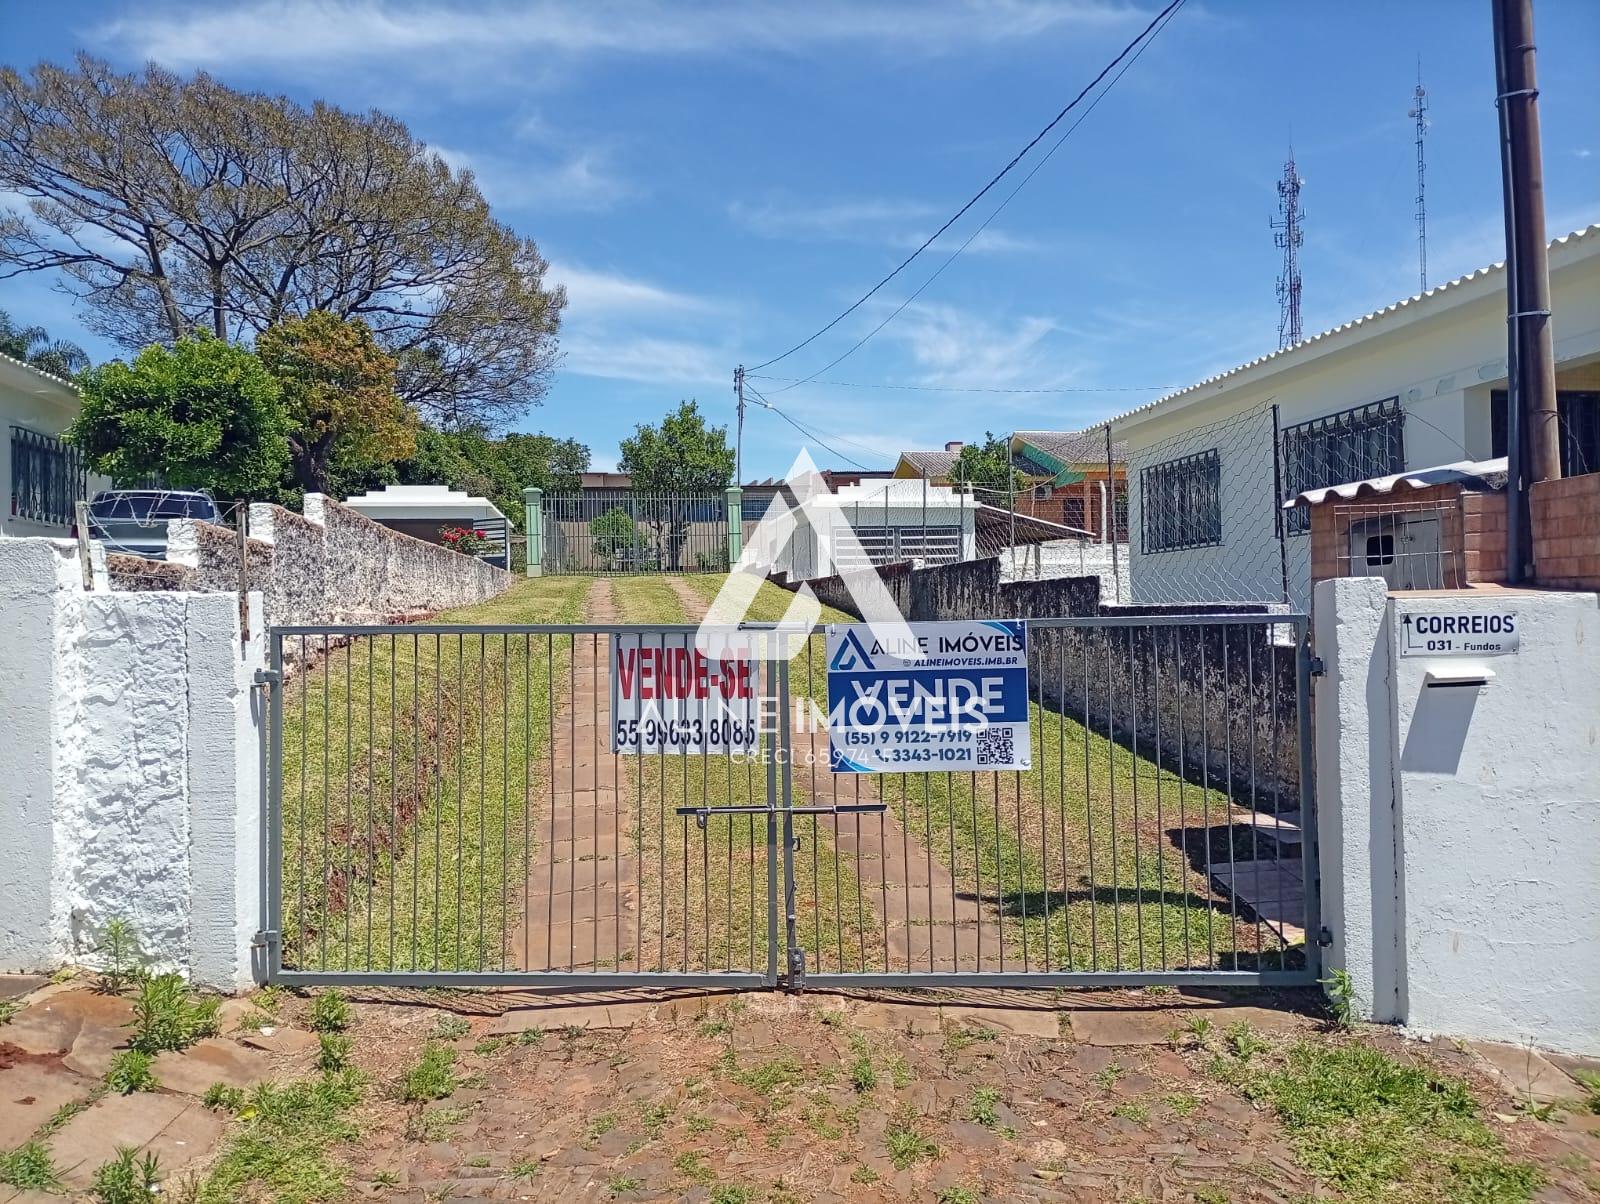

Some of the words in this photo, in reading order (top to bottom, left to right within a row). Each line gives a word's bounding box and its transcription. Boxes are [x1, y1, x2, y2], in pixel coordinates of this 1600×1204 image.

[1416, 616, 1515, 634] CORREIOS
[870, 637, 929, 655] ALINE
[939, 632, 1024, 653] IMÓVEIS
[1427, 640, 1452, 651] 031
[1464, 642, 1502, 651] Fundos
[913, 657, 1018, 667] ALINEIMOVEIS.IMB.BR
[618, 648, 754, 700] VENDE-SE
[851, 677, 1004, 717] VENDE
[617, 720, 639, 746] 55
[845, 731, 875, 745] (55)
[880, 731, 889, 744] 9
[894, 730, 972, 744] 9122-7919
[892, 748, 972, 762] 3343-1021
